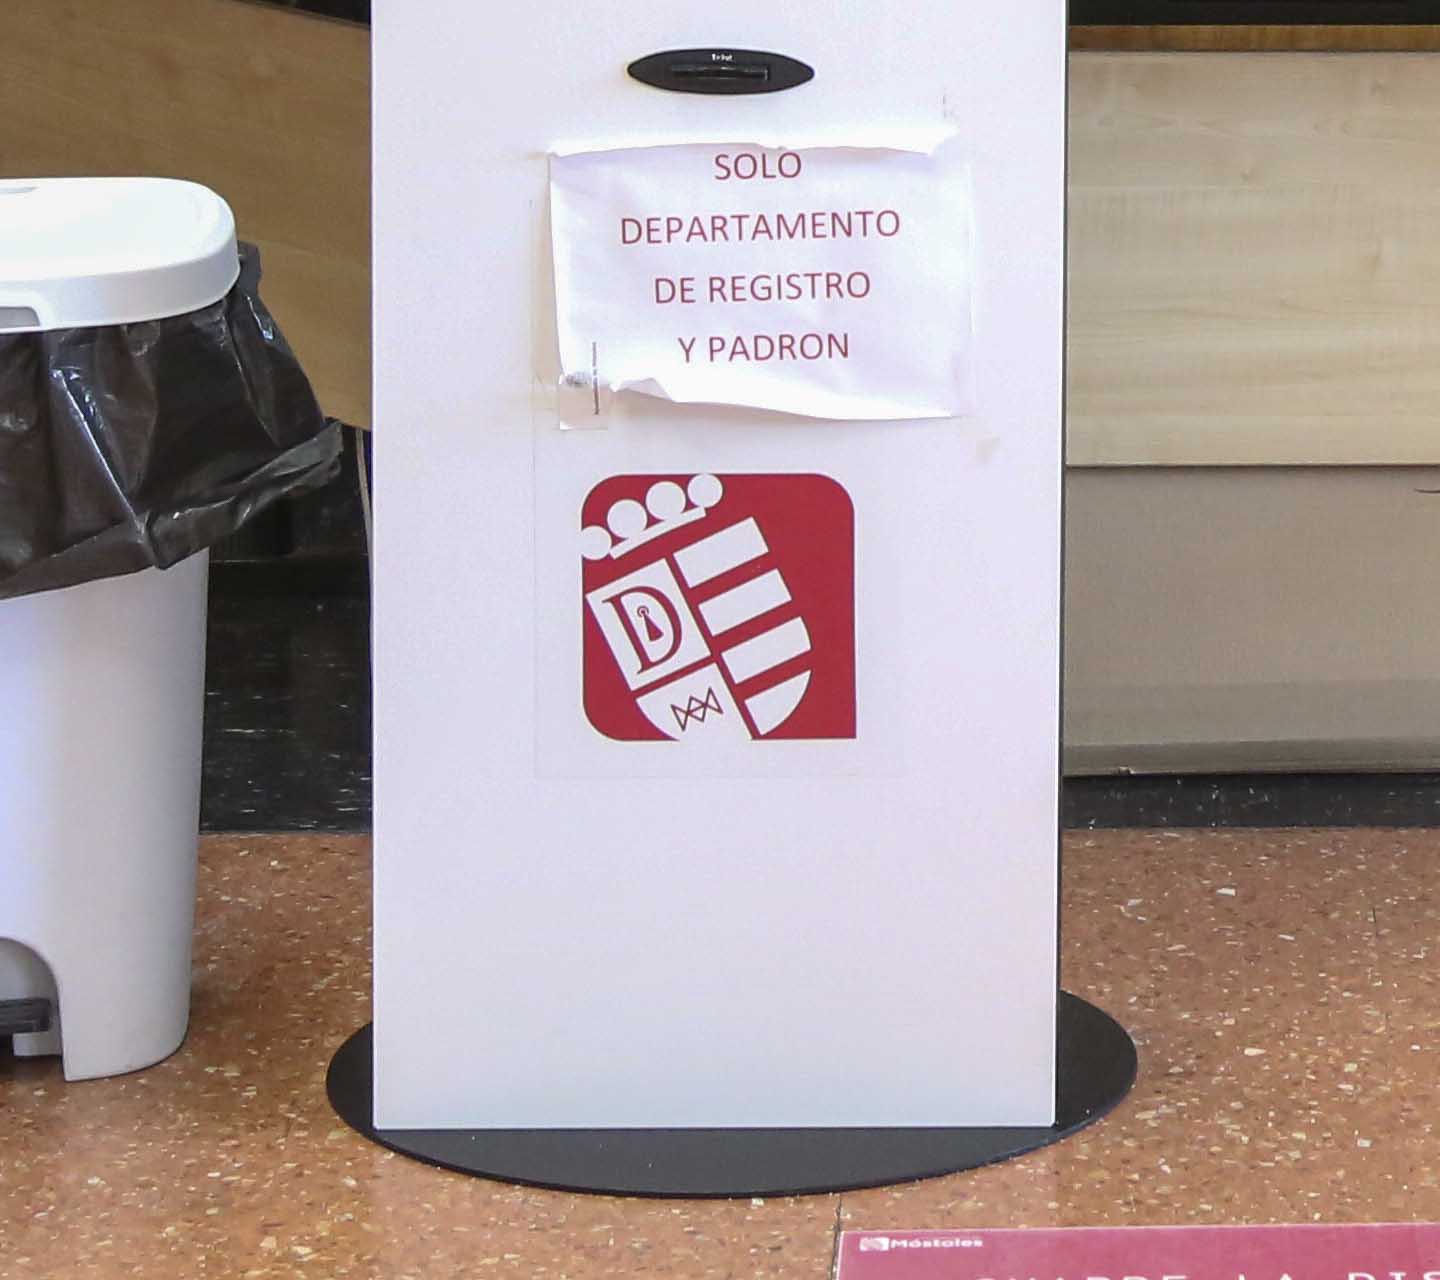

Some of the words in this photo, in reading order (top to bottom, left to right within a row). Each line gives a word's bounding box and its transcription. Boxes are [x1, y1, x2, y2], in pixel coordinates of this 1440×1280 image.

[714, 150, 802, 180] SOLO
[620, 209, 900, 245] DEPARTAMENTO
[654, 276, 696, 304] DE
[708, 270, 870, 303] REGISTRO
[677, 336, 696, 363] Y
[708, 332, 849, 362] PADRON
[891, 1236, 984, 1249] Móstoles
